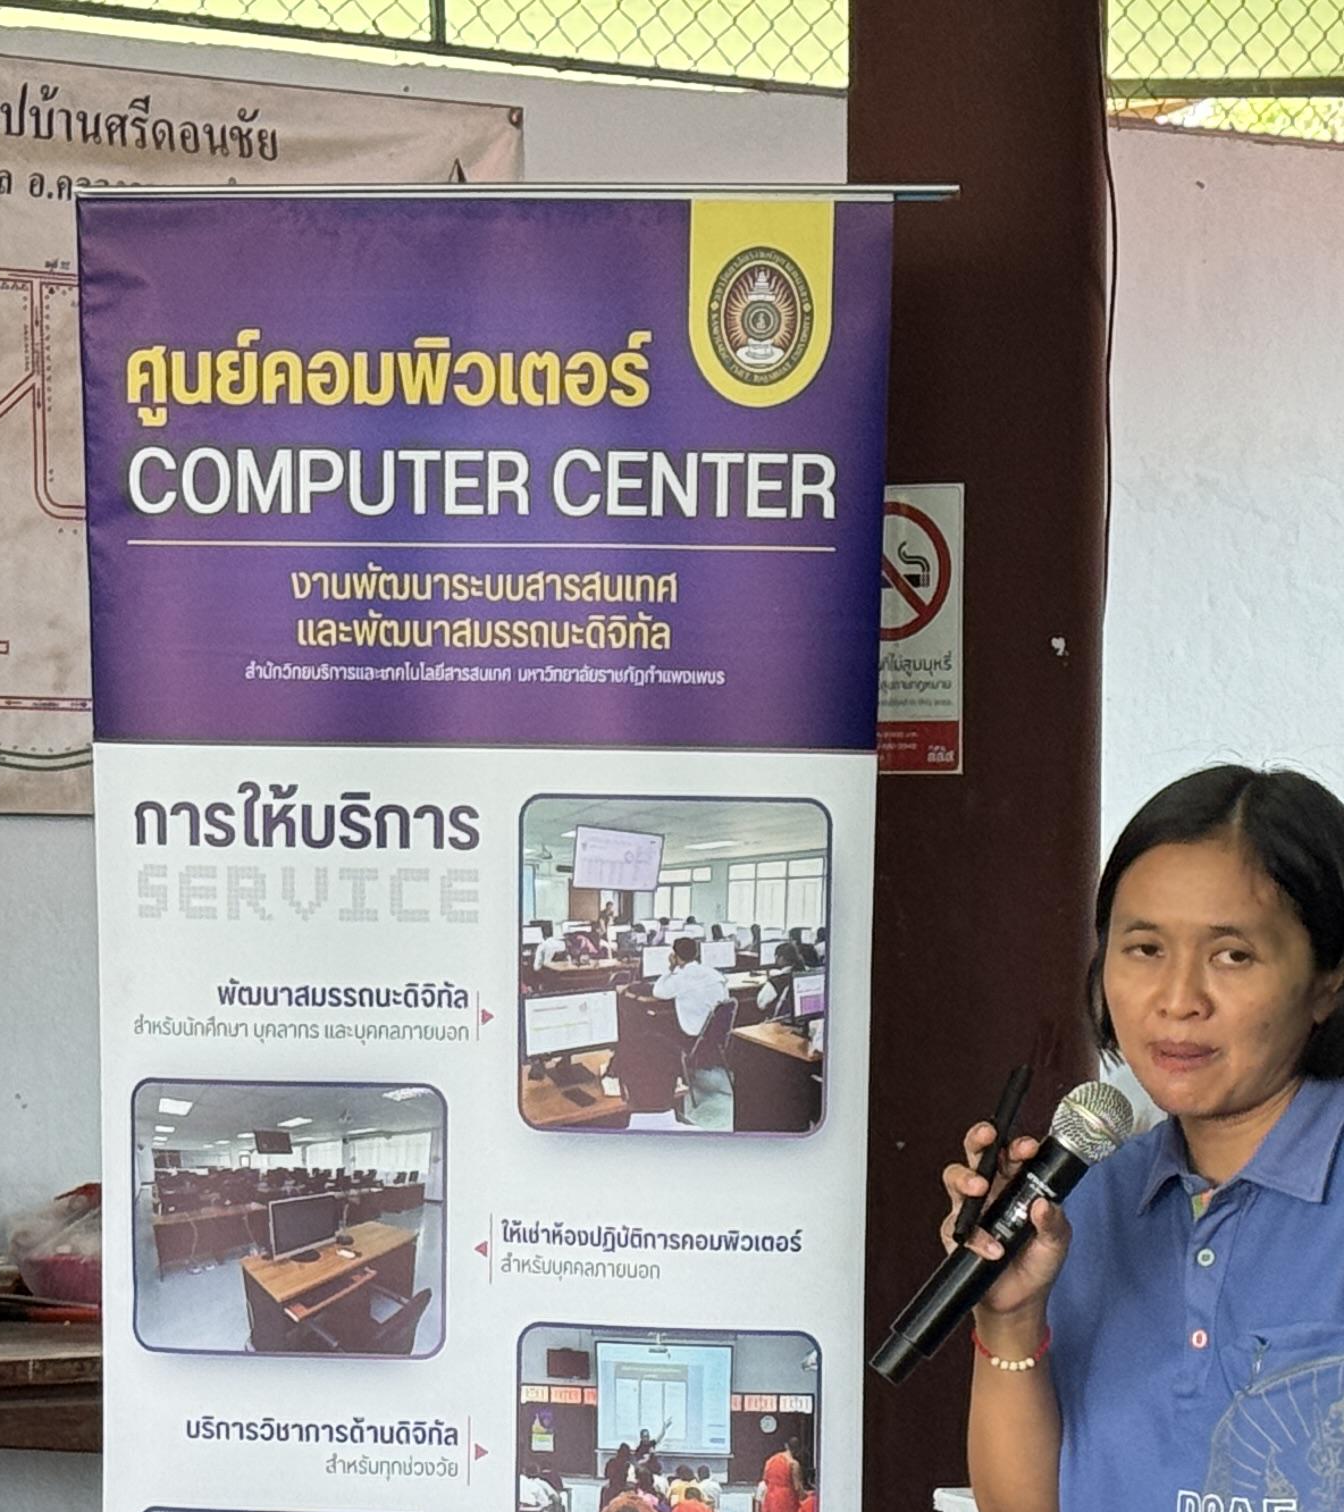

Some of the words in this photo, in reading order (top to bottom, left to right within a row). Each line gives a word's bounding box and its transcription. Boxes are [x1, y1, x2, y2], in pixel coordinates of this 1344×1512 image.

[127, 329, 651, 426] ศูนย์คอมพิวเตอร์
[128, 446, 530, 517] COMPUTER
[554, 447, 836, 520] CENTER
[291, 562, 678, 603] งานพัฒนาระบบสารสนเทศ
[297, 609, 671, 650] และพัฒนาสมรรถนะดิจิทัล
[134, 781, 481, 850] การให้บริการ
[137, 863, 480, 924] SERVICE
[217, 977, 470, 1010] พัฒนาสมรรถนะดิจิทัล
[254, 1023, 320, 1044] บุคลากร
[324, 1024, 470, 1046] และบุคคลภายนอก
[501, 1219, 803, 1252] ให้เช่าห้องปฏิบัติการคอมพิวเตอร์
[501, 1252, 661, 1282] สำหรับบุคคลภายนอก
[185, 1416, 459, 1447] บริการวิชาการด้านดิจิทัล
[325, 1453, 459, 1481] สำหรับทุกช่วงวัย
